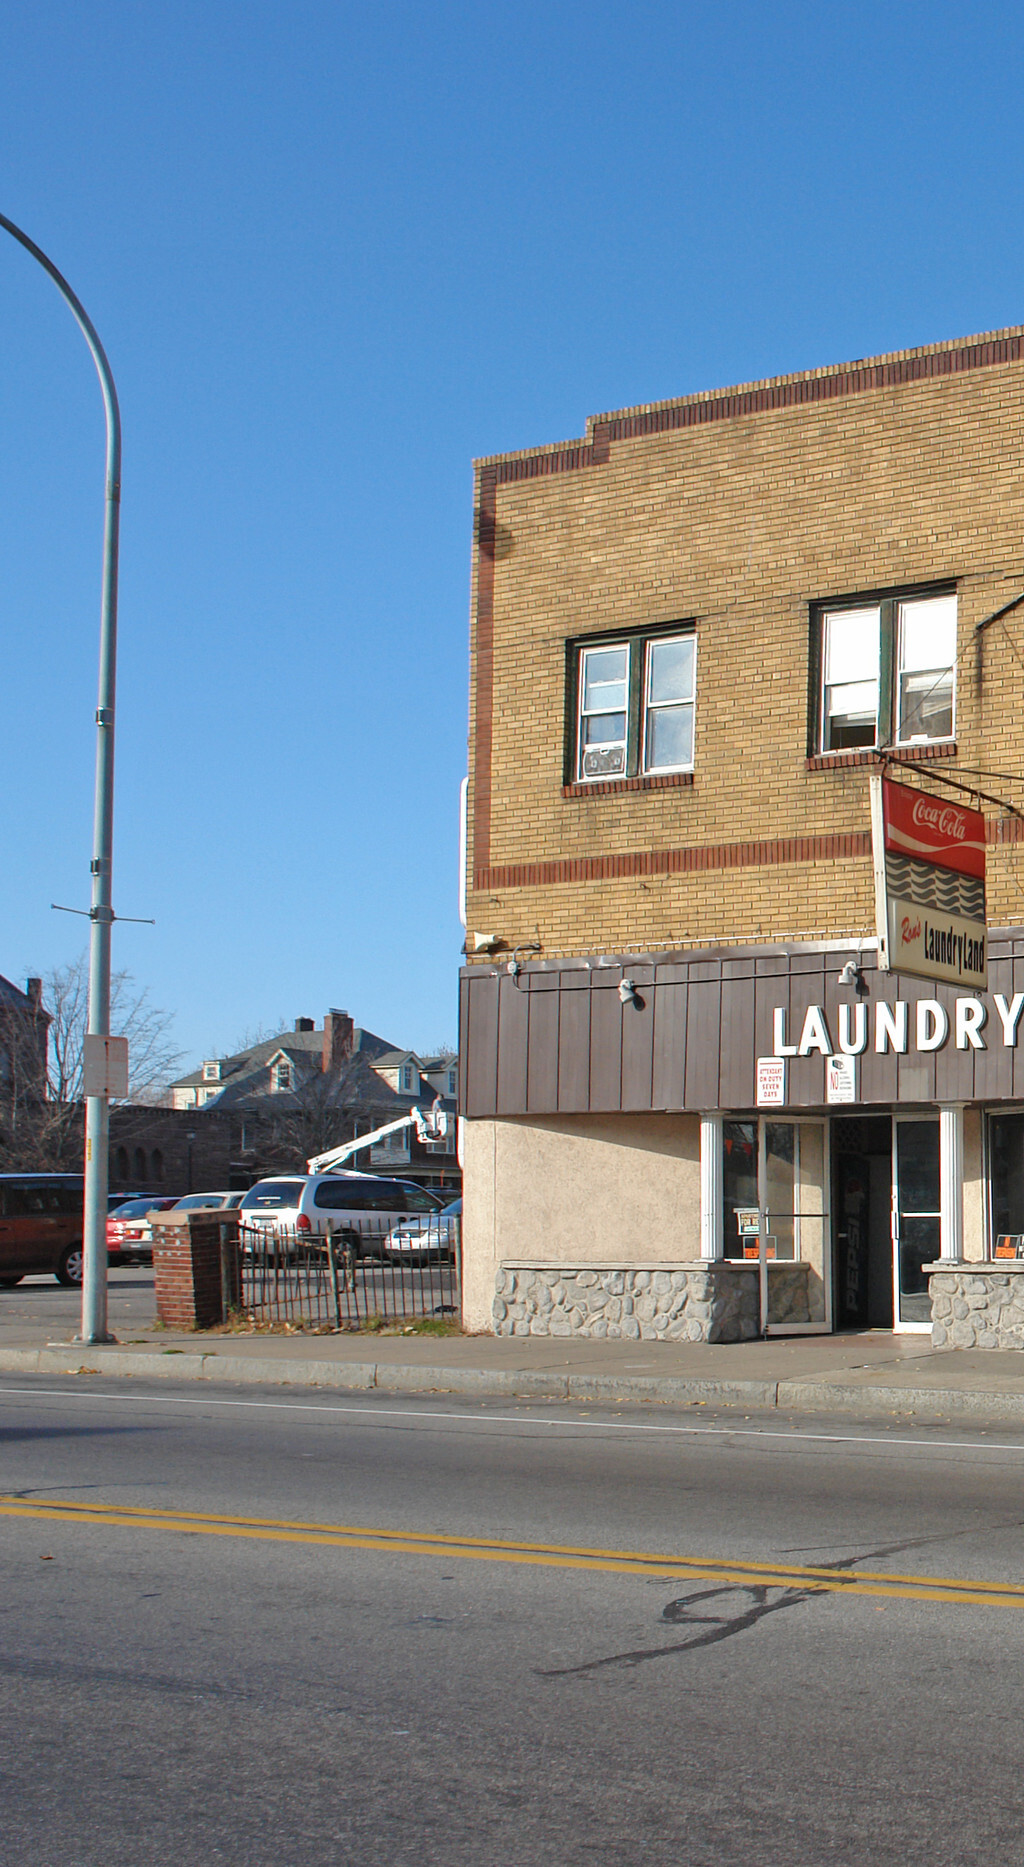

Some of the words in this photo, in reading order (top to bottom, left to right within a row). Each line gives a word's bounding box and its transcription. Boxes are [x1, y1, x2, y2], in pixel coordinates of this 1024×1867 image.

[912, 798, 966, 840] Coca-Cola
[762, 1083, 780, 1091] SEVEN
[846, 1217, 860, 1311] PEPSI
